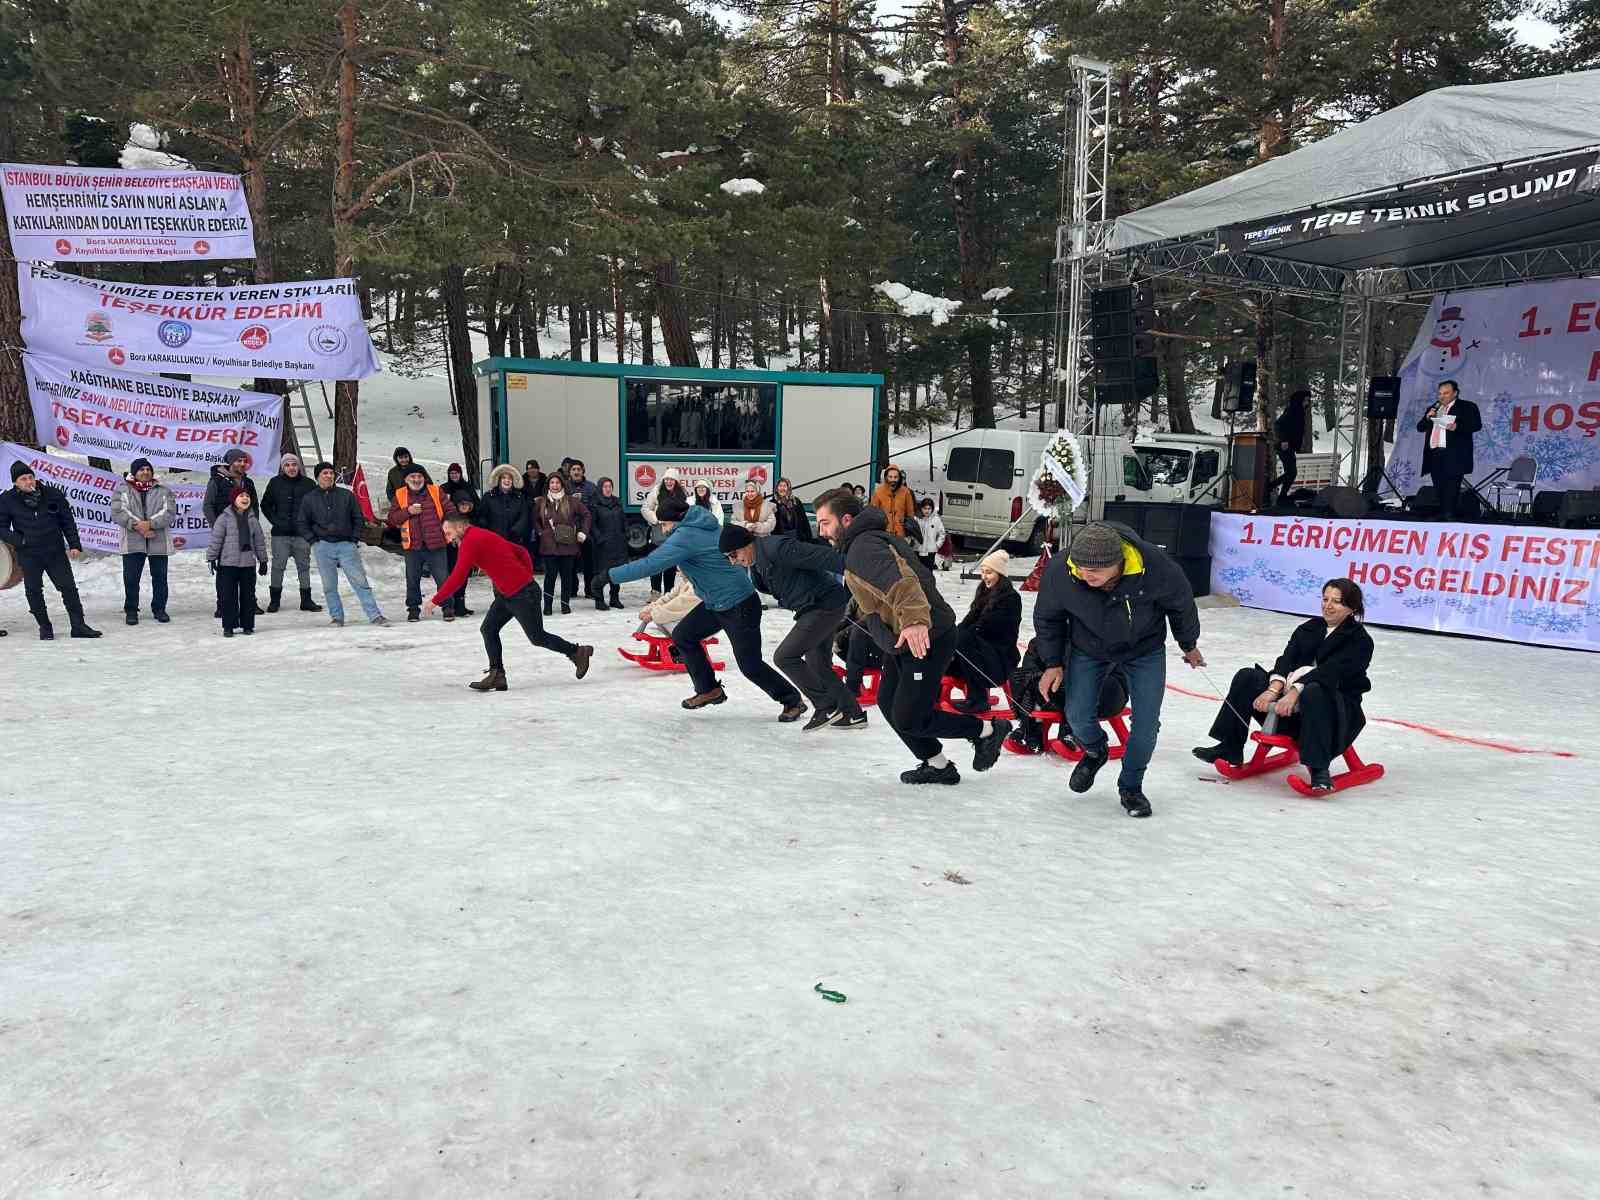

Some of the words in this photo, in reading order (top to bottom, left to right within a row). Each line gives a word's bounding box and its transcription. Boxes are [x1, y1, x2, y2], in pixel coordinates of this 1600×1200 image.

[55, 172, 91, 187] BÜYÜK
[92, 174, 123, 191] ŞEHİR
[124, 176, 171, 188] BELEDİYE
[172, 176, 212, 192] BAŞKAN
[26, 191, 109, 212] HEMŞEHRİMİZ
[111, 194, 145, 209] SAYIN
[148, 193, 176, 210] NURİ
[179, 196, 228, 212] ASLAN'A
[1300, 210, 1365, 232] TEPE
[1372, 199, 1462, 223] TEKNİK
[1468, 168, 1577, 209] SOUND
[13, 214, 100, 231] KATKILARINDAN
[102, 215, 142, 230] DOLAYI
[144, 215, 208, 234] TEŞEKKÜR
[208, 215, 248, 232] EDERİZ
[1243, 231, 1261, 241] TEPE
[100, 292, 227, 320] TEŞEKKÜR
[233, 299, 322, 320] EDERİM
[163, 290, 224, 302] DESTEK
[229, 289, 280, 301] VEREN
[1519, 306, 1552, 338] 1.
[129, 352, 147, 362] Bora
[212, 357, 250, 369] Koyulhisar
[251, 359, 283, 370] Belediye
[284, 361, 315, 372] Başkanı
[70, 369, 135, 393] KAĞITHANE
[136, 381, 189, 401] BELEDİYE
[192, 390, 240, 408] BAŞKANI
[80, 391, 107, 407] SAYIN
[188, 408, 255, 425] KATKILARINDAN
[1511, 401, 1600, 437] HOŞ
[175, 427, 259, 447] EDERİZ
[139, 446, 176, 459] Koyulhisar
[204, 452, 226, 464] Başka
[30, 459, 94, 486] ATAŞEHİR
[94, 476, 117, 491] BEL
[1240, 522, 1263, 545] 1.
[1271, 519, 1428, 557] EĞRİÇİMEN
[1436, 532, 1490, 562] KIŞ
[1501, 532, 1600, 568] FESTİ
[1349, 562, 1590, 605] HOŞGELDİNİZ
